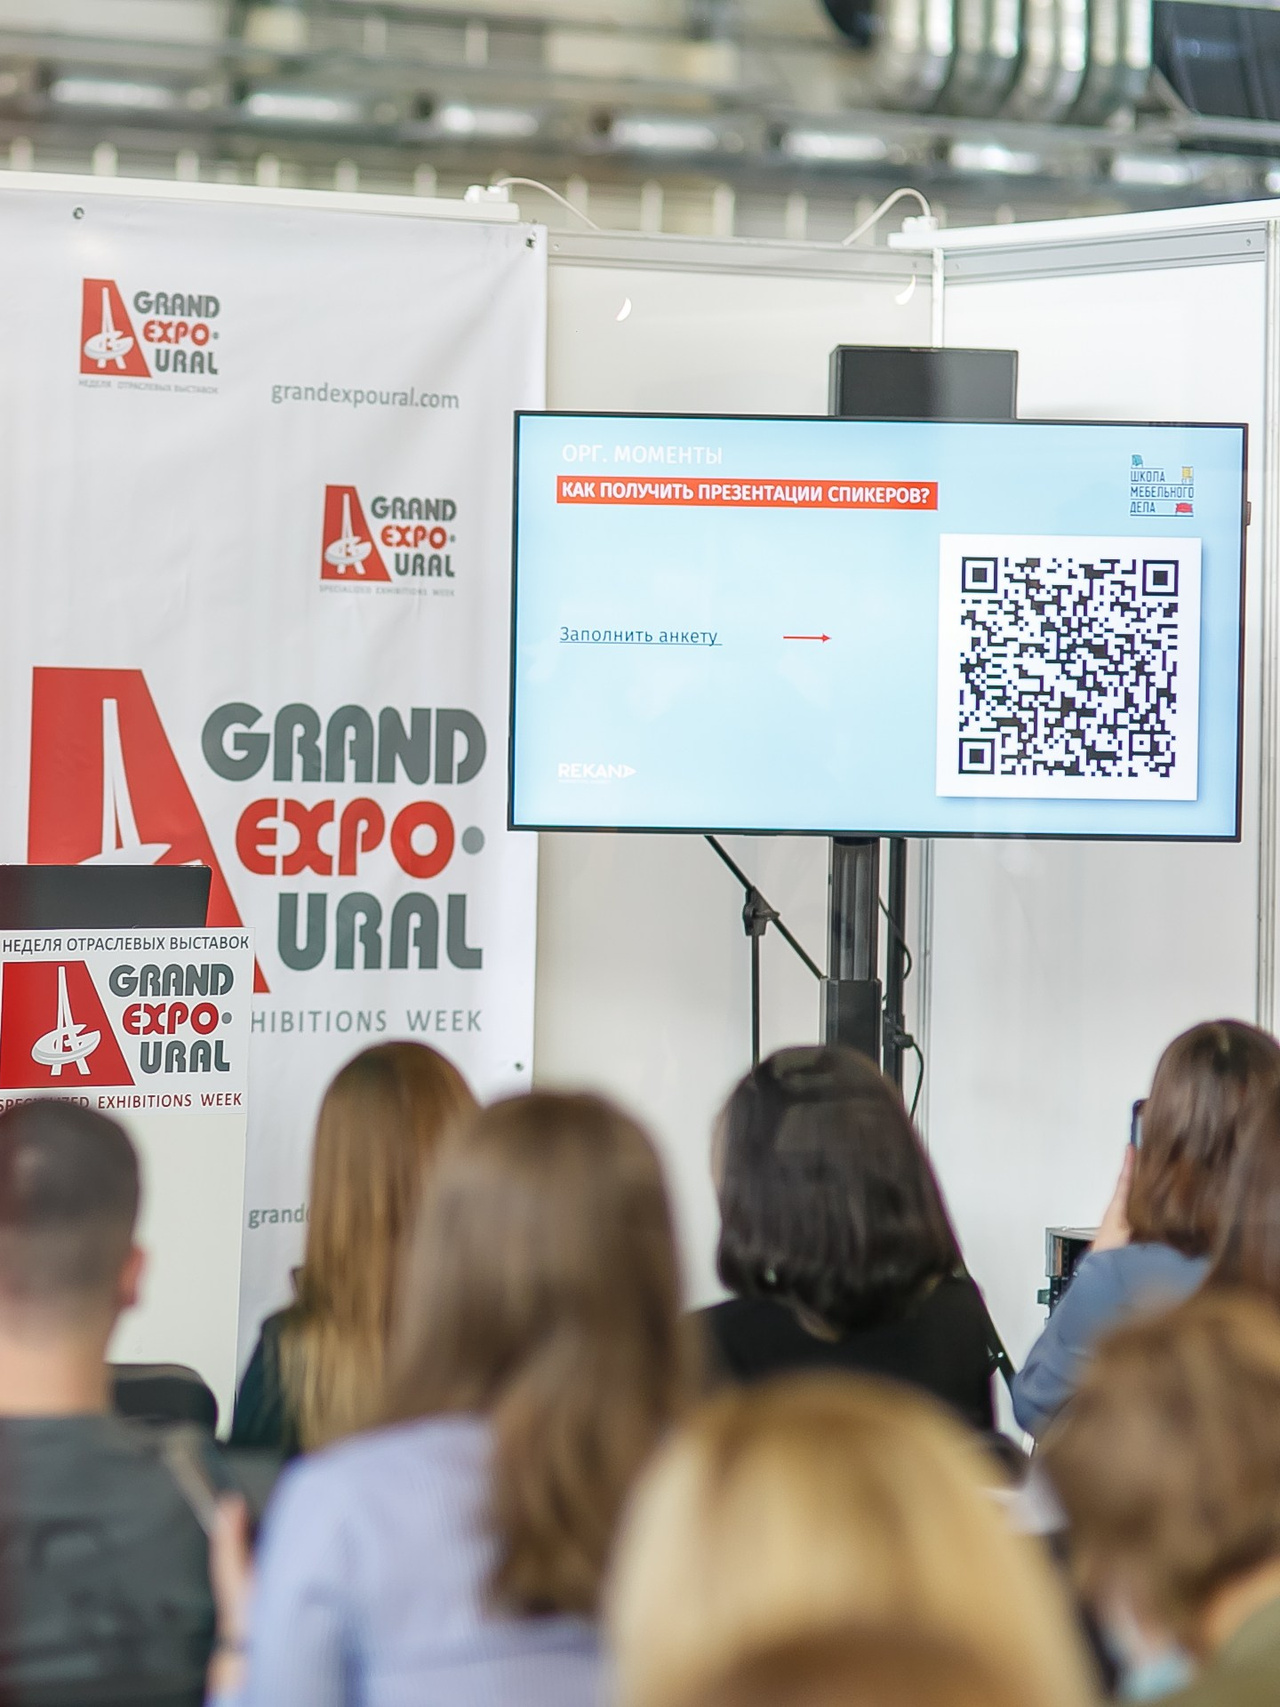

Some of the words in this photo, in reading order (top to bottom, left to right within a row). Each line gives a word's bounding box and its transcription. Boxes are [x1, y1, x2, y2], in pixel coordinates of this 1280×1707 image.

[133, 290, 221, 318] GRAND
[143, 320, 210, 346] EXPO
[155, 348, 219, 375] URAL
[271, 382, 460, 409] grandexpoural.com
[561, 444, 607, 463] ОРГ.
[614, 445, 723, 465] МОМЕНТЫ
[1130, 470, 1165, 482] ШКОЛА
[561, 481, 596, 498] КАК
[600, 482, 694, 500] ПОЛУЧИТЬ
[698, 484, 822, 504] ПРЕЗЕНТАЦИИ
[827, 485, 930, 504] СПИКЕРОВ?
[1130, 486, 1194, 498] МЕБЕЛЬНОГО
[370, 496, 457, 521] GRAND
[1130, 501, 1156, 513] ДЕЛА
[381, 525, 447, 549] EXPO
[394, 552, 455, 578] URAL
[560, 626, 653, 643] Заполнить
[659, 630, 718, 647] анкету
[201, 702, 487, 785] GRAND
[235, 797, 455, 879] EXPO
[277, 892, 483, 970] URAL
[3, 938, 62, 955] НЕДЕЛЯ
[67, 937, 166, 952] ОТРАСЛЕВЫХ
[170, 935, 250, 950] ВЫСТАВОК
[109, 963, 234, 997] GRAND
[122, 1002, 219, 1035] EXPO
[406, 1010, 483, 1032] WEEK
[140, 1040, 230, 1074] URAL
[98, 1094, 192, 1109] EXHIBITIONS
[201, 1093, 242, 1107] WEEK
